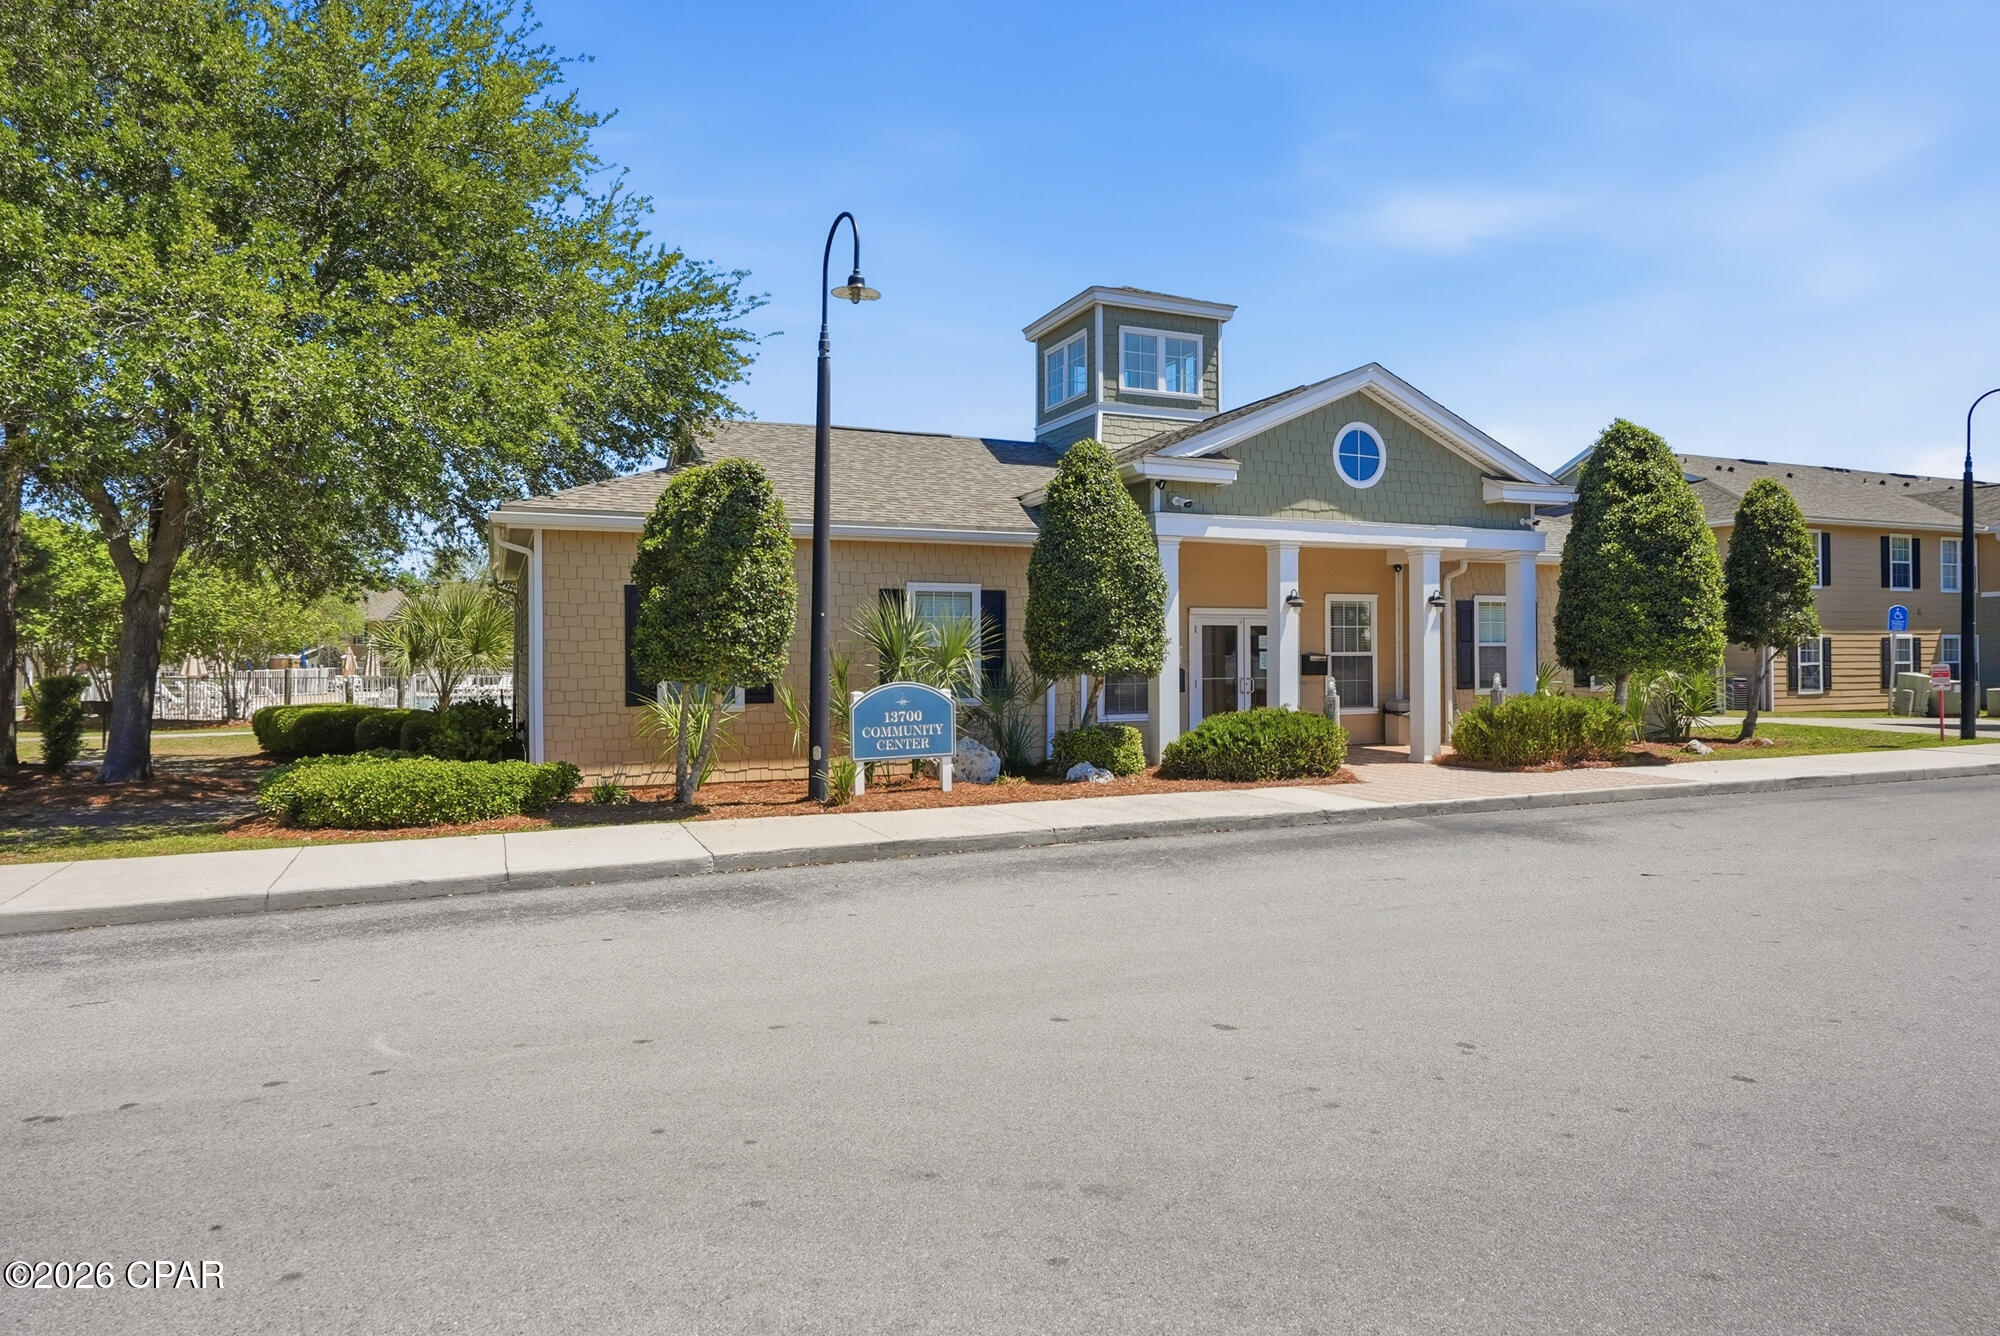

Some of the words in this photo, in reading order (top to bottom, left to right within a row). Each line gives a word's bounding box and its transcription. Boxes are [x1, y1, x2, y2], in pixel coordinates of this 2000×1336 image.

[884, 710, 923, 723] 13700
[862, 723, 944, 738] COMMUNITY
[876, 737, 930, 751] CENTER
